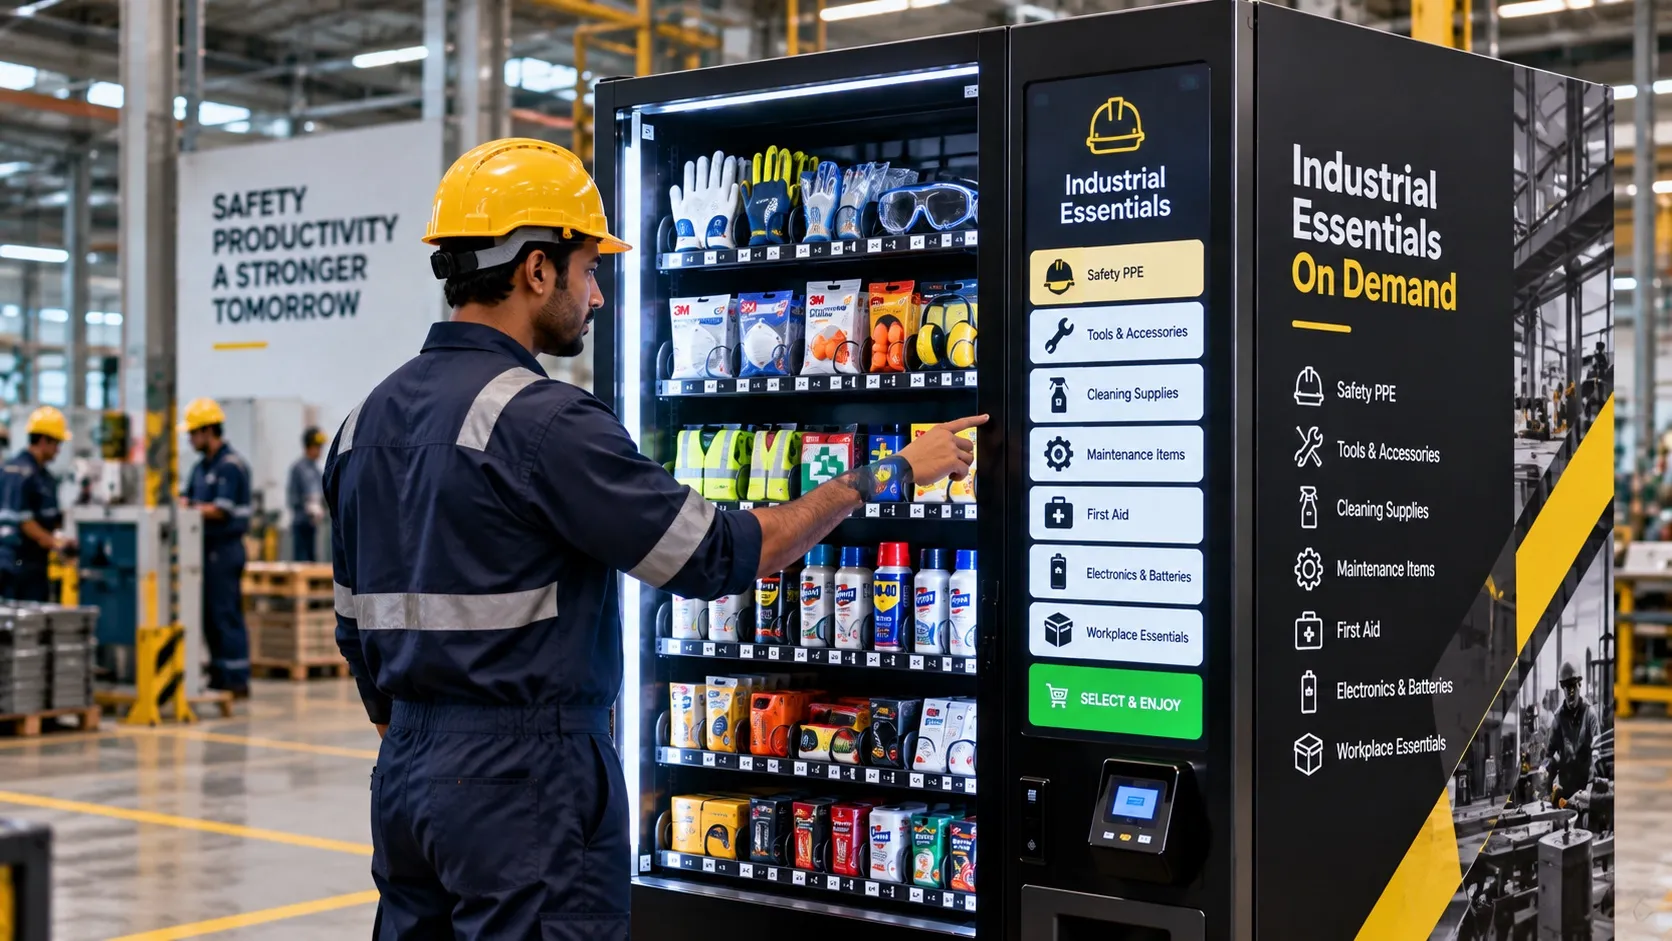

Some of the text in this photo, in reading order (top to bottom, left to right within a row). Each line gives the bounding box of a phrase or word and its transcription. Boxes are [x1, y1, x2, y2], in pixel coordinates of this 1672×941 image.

[1065, 166, 1166, 195] Industrial
[1292, 143, 1437, 209] Industrial
[212, 185, 308, 222] SAFETY
[1060, 194, 1171, 224] Essentials
[213, 214, 399, 255] PRODUCTIVITY
[1292, 197, 1443, 260] Essentials
[212, 254, 367, 290] A STRONGER
[1087, 266, 1143, 282] Safety PPE
[1292, 252, 1456, 310] On Demand
[212, 292, 361, 324] TOMORROW
[674, 305, 690, 316] 3M
[809, 295, 825, 305] 3M
[1086, 326, 1188, 340] Tools & Accessories
[1087, 387, 1178, 402] Cleaning Supplies
[1337, 381, 1396, 403] Safety PPE
[1087, 449, 1185, 460] Maintenance Items
[1336, 441, 1440, 462] Tools & Accessories
[1087, 508, 1128, 520] First Aid
[1336, 499, 1428, 521] Cleaning Supplies
[1086, 568, 1191, 582] Electronics & Batteries
[1337, 560, 1435, 577] Maintenance Items
[1086, 627, 1188, 643] Workplace Essentials
[1337, 621, 1380, 638] First Aid
[1337, 677, 1453, 699] Electronics & Batteries
[1080, 692, 1181, 711] SELECT & ENJOY
[1336, 734, 1446, 761] Workplace Essentials
